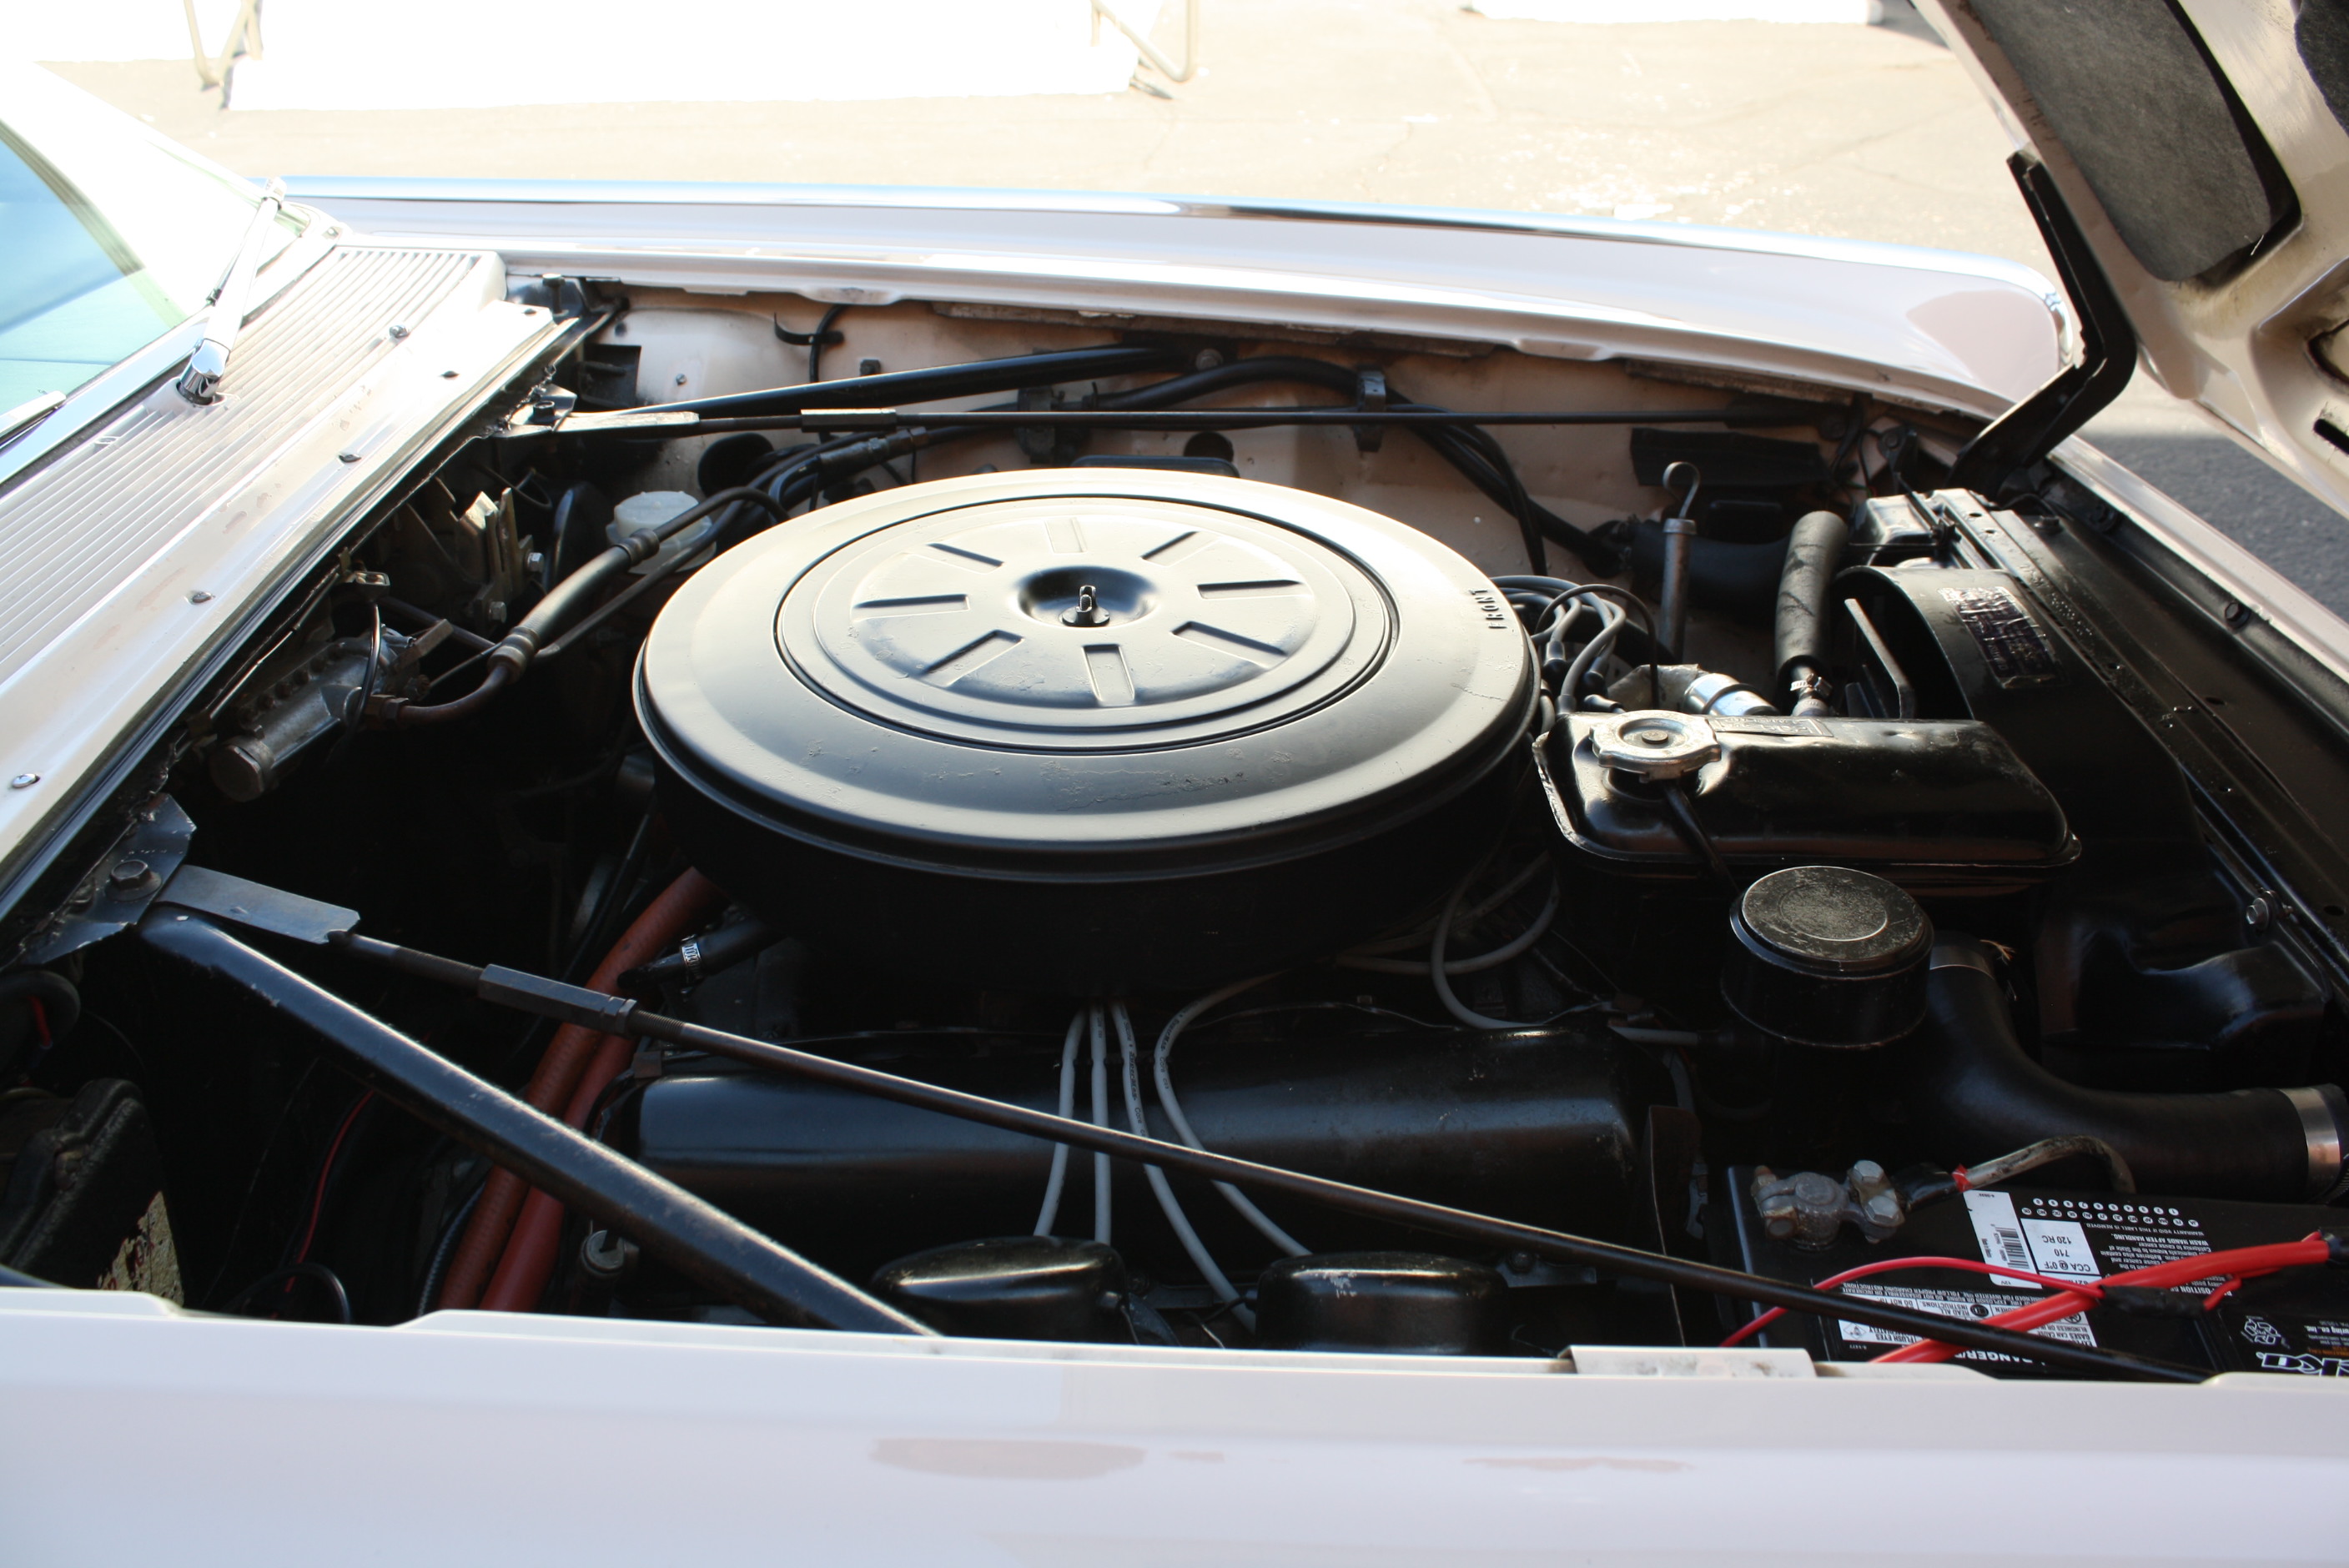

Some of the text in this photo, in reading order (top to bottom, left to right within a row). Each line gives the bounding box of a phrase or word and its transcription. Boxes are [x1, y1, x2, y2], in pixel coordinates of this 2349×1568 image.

[1468, 589, 1507, 629] FRONT
[2042, 1235, 2072, 1244] 120 RC
[2054, 1249, 2070, 1258] 710
[2058, 1260, 2069, 1270] @
[2070, 1263, 2090, 1272] CCA
